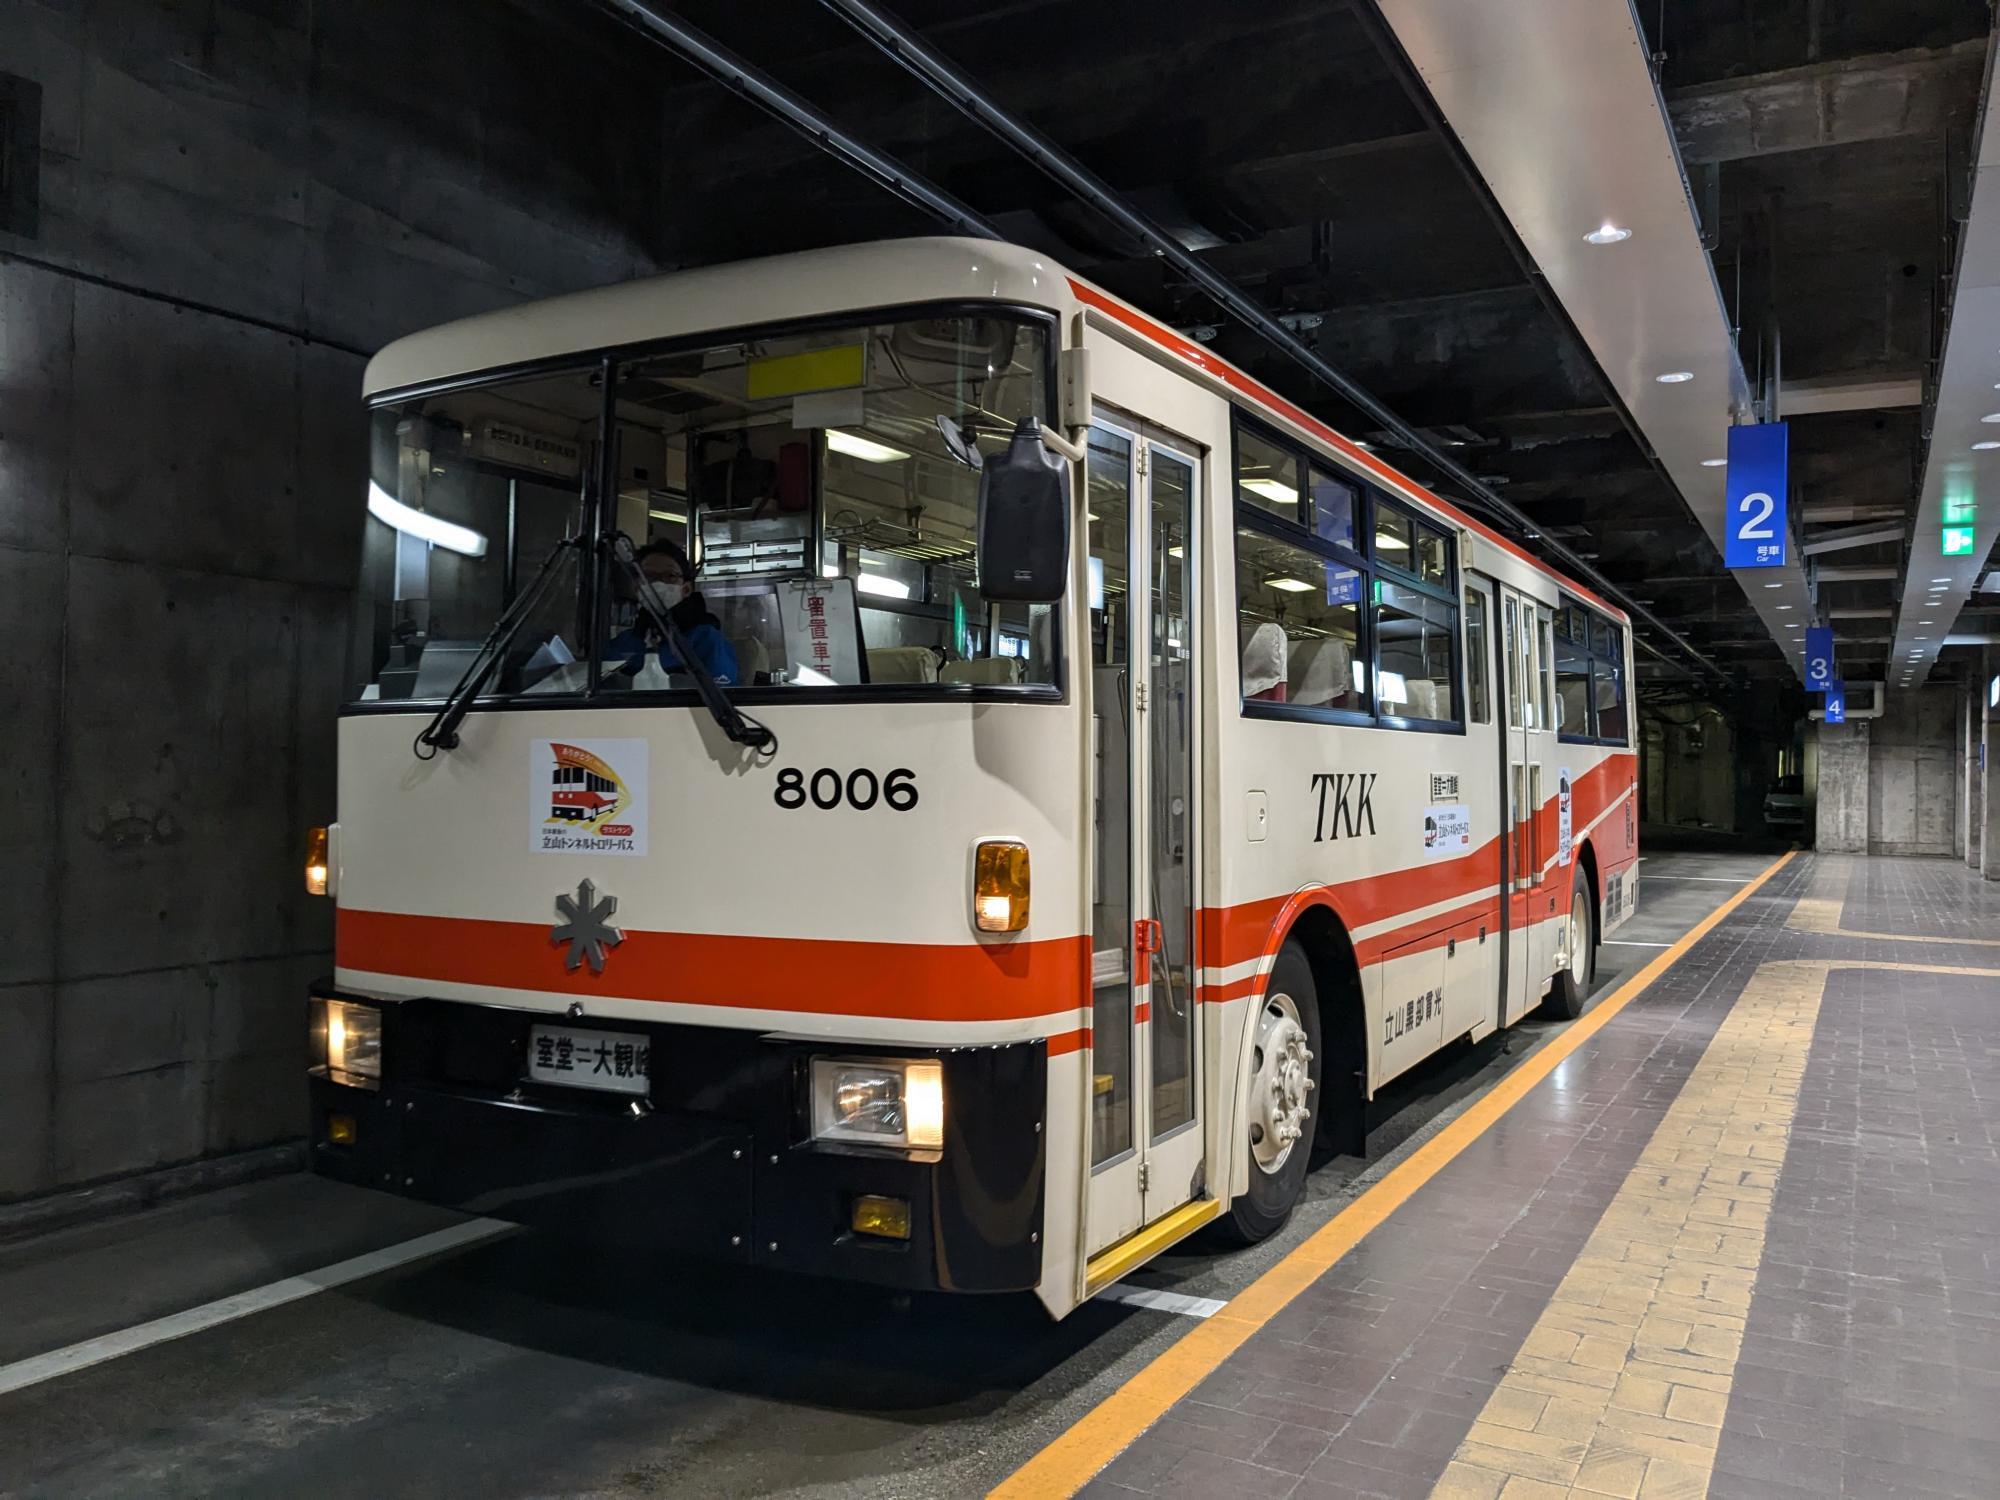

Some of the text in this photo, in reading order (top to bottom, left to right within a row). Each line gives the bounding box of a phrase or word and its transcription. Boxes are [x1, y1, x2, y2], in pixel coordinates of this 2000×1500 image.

[1738, 492, 1774, 540] 2
[1756, 555, 1770, 563] Car
[1757, 545, 1780, 556] 号車
[1810, 657, 1828, 680] 3
[1828, 700, 1841, 715] 4
[774, 767, 919, 812] 8006
[1310, 773, 1378, 843] TKK
[542, 836, 634, 851] 立山トンネルトロリーバス
